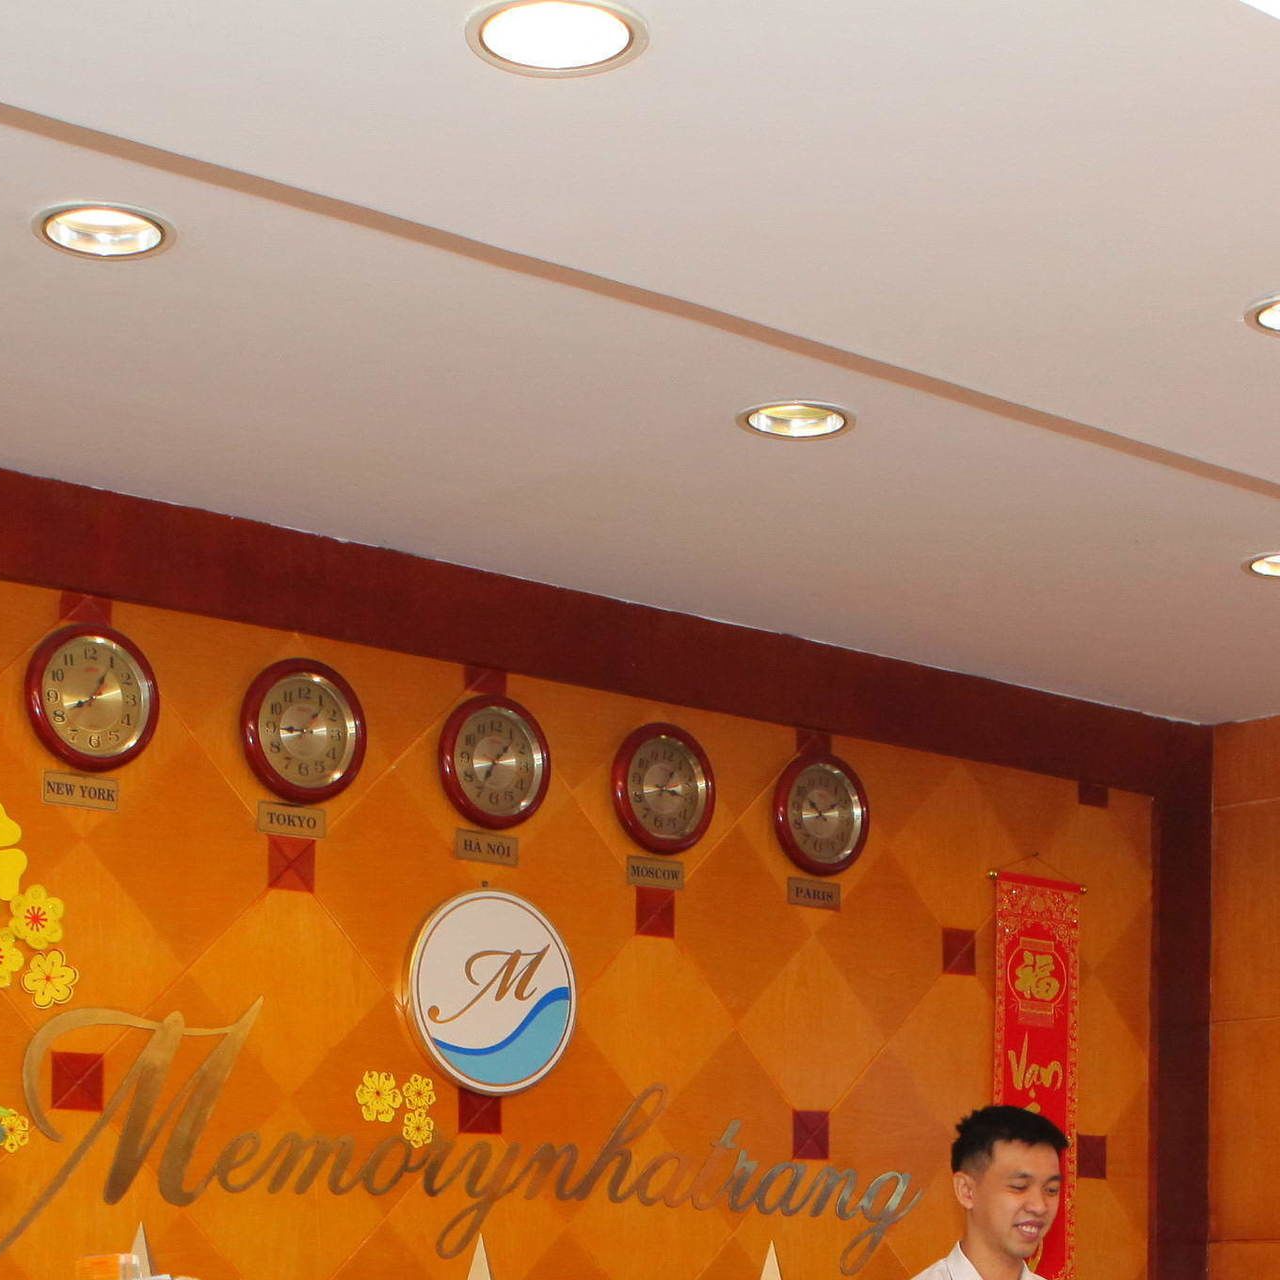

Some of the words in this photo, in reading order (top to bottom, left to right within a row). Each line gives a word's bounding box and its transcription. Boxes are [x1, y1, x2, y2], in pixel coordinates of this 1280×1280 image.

[46, 780, 76, 797] NEW
[80, 785, 116, 802] YORK
[266, 811, 317, 830] TOKYO
[630, 864, 681, 881] MOSCOW
[794, 886, 834, 903] PARIS
[427, 943, 551, 1025] M
